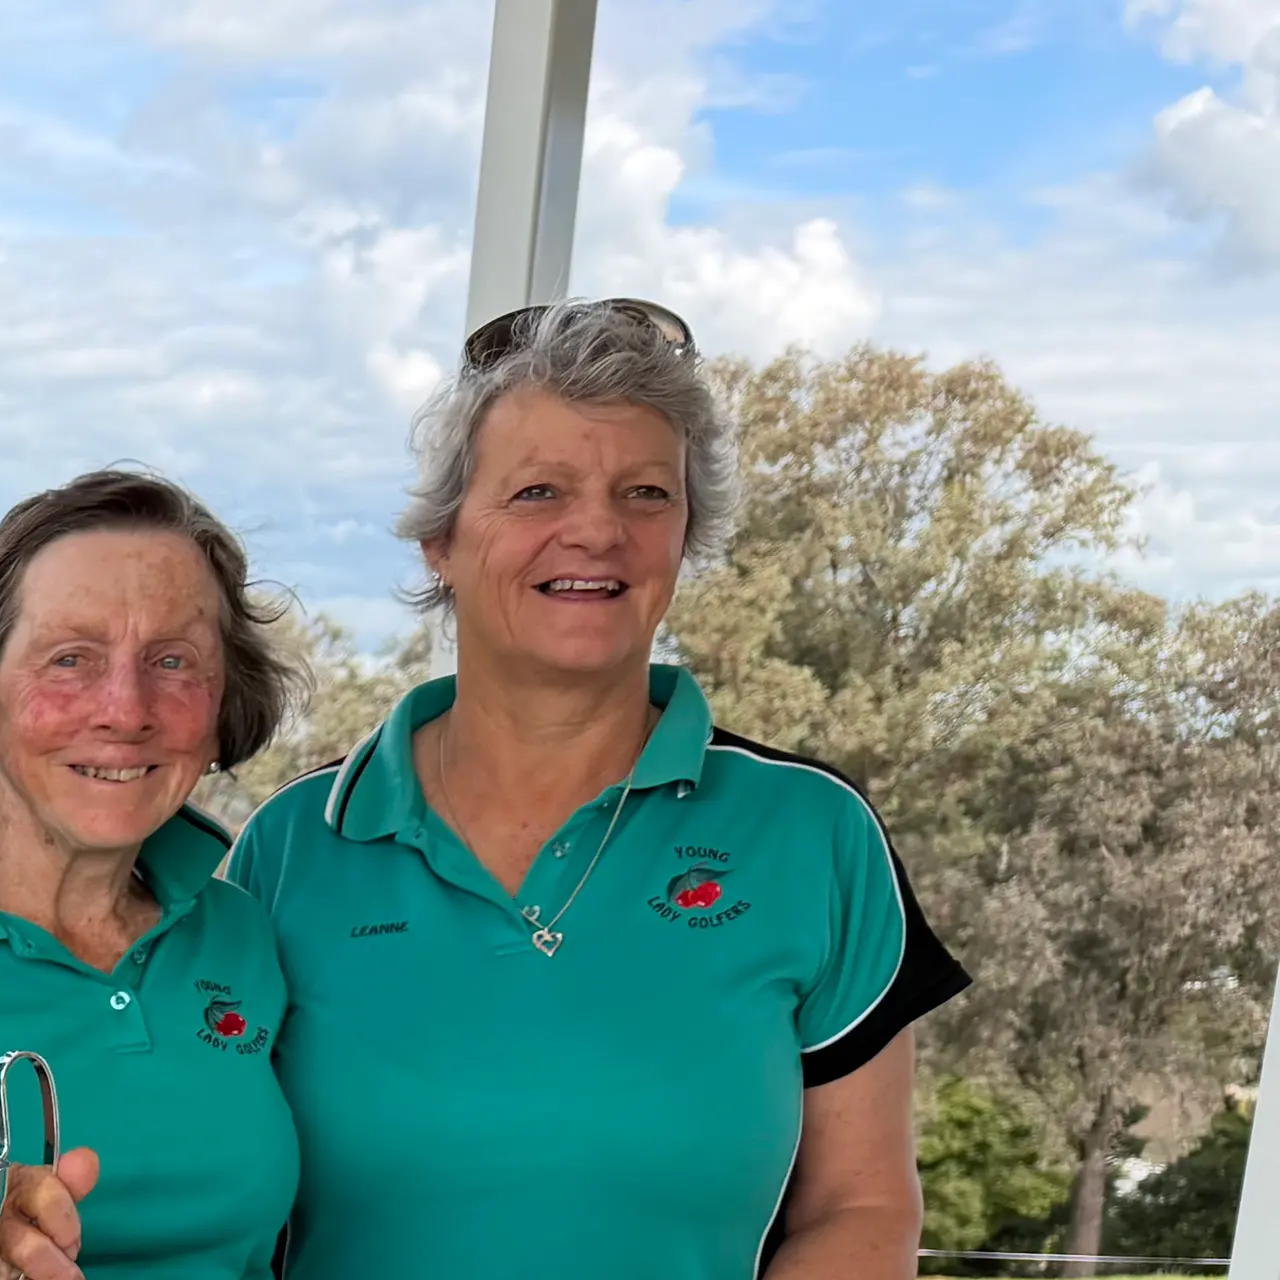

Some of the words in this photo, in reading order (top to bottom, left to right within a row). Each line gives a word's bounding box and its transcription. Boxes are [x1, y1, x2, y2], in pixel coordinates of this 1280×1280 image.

[674, 846, 731, 863] YOUNG
[647, 896, 681, 923] LADY
[688, 900, 751, 929] GOLFERS
[350, 920, 409, 938] LEANNE
[196, 1028, 228, 1051] LADY
